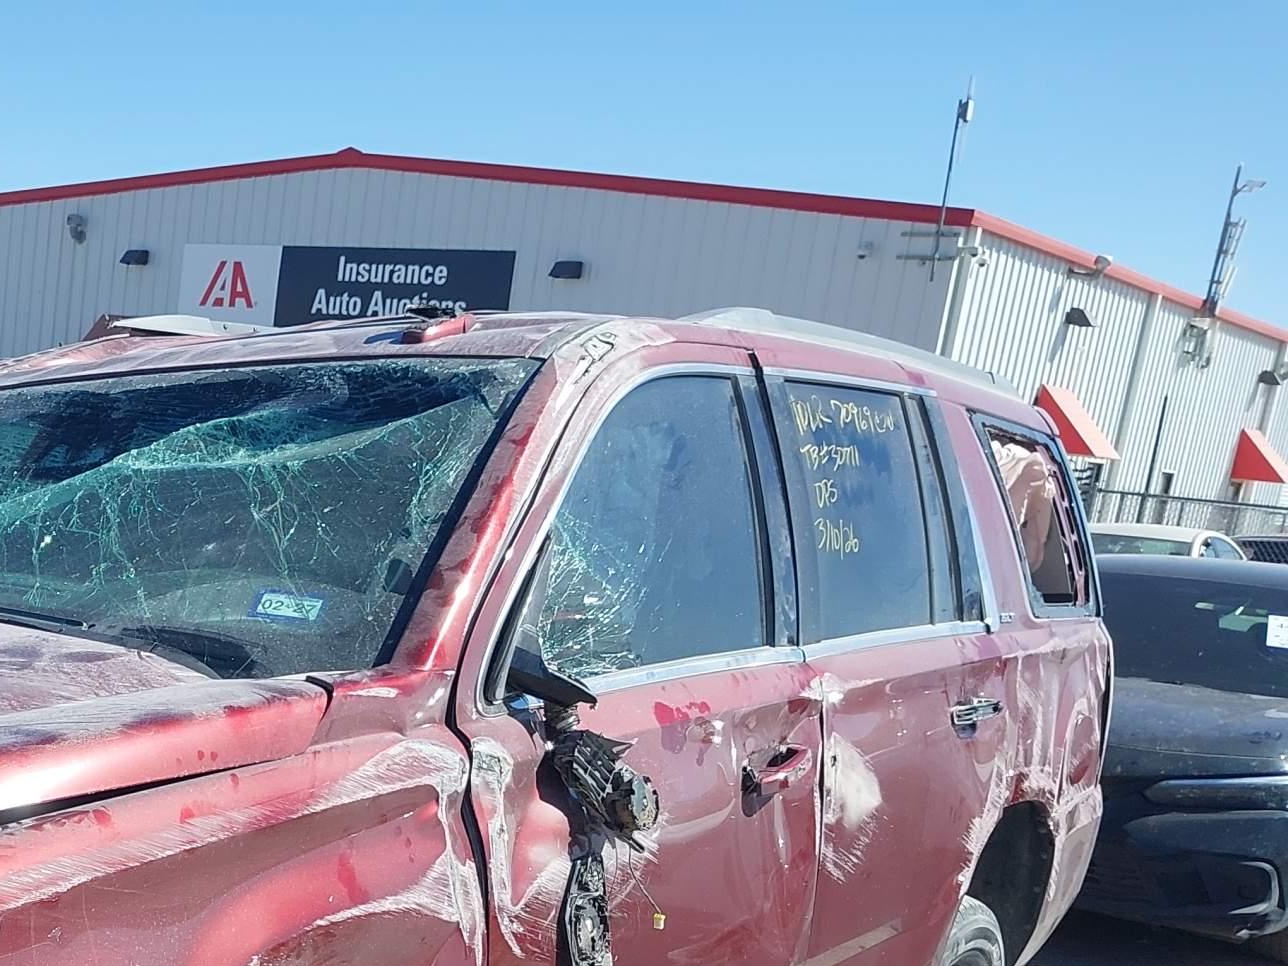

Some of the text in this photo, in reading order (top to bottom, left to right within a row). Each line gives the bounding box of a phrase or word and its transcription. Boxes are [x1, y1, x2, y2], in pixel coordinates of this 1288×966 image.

[337, 255, 448, 285] Insurance
[311, 288, 360, 316] Auto
[814, 517, 860, 560] 3/10/26
